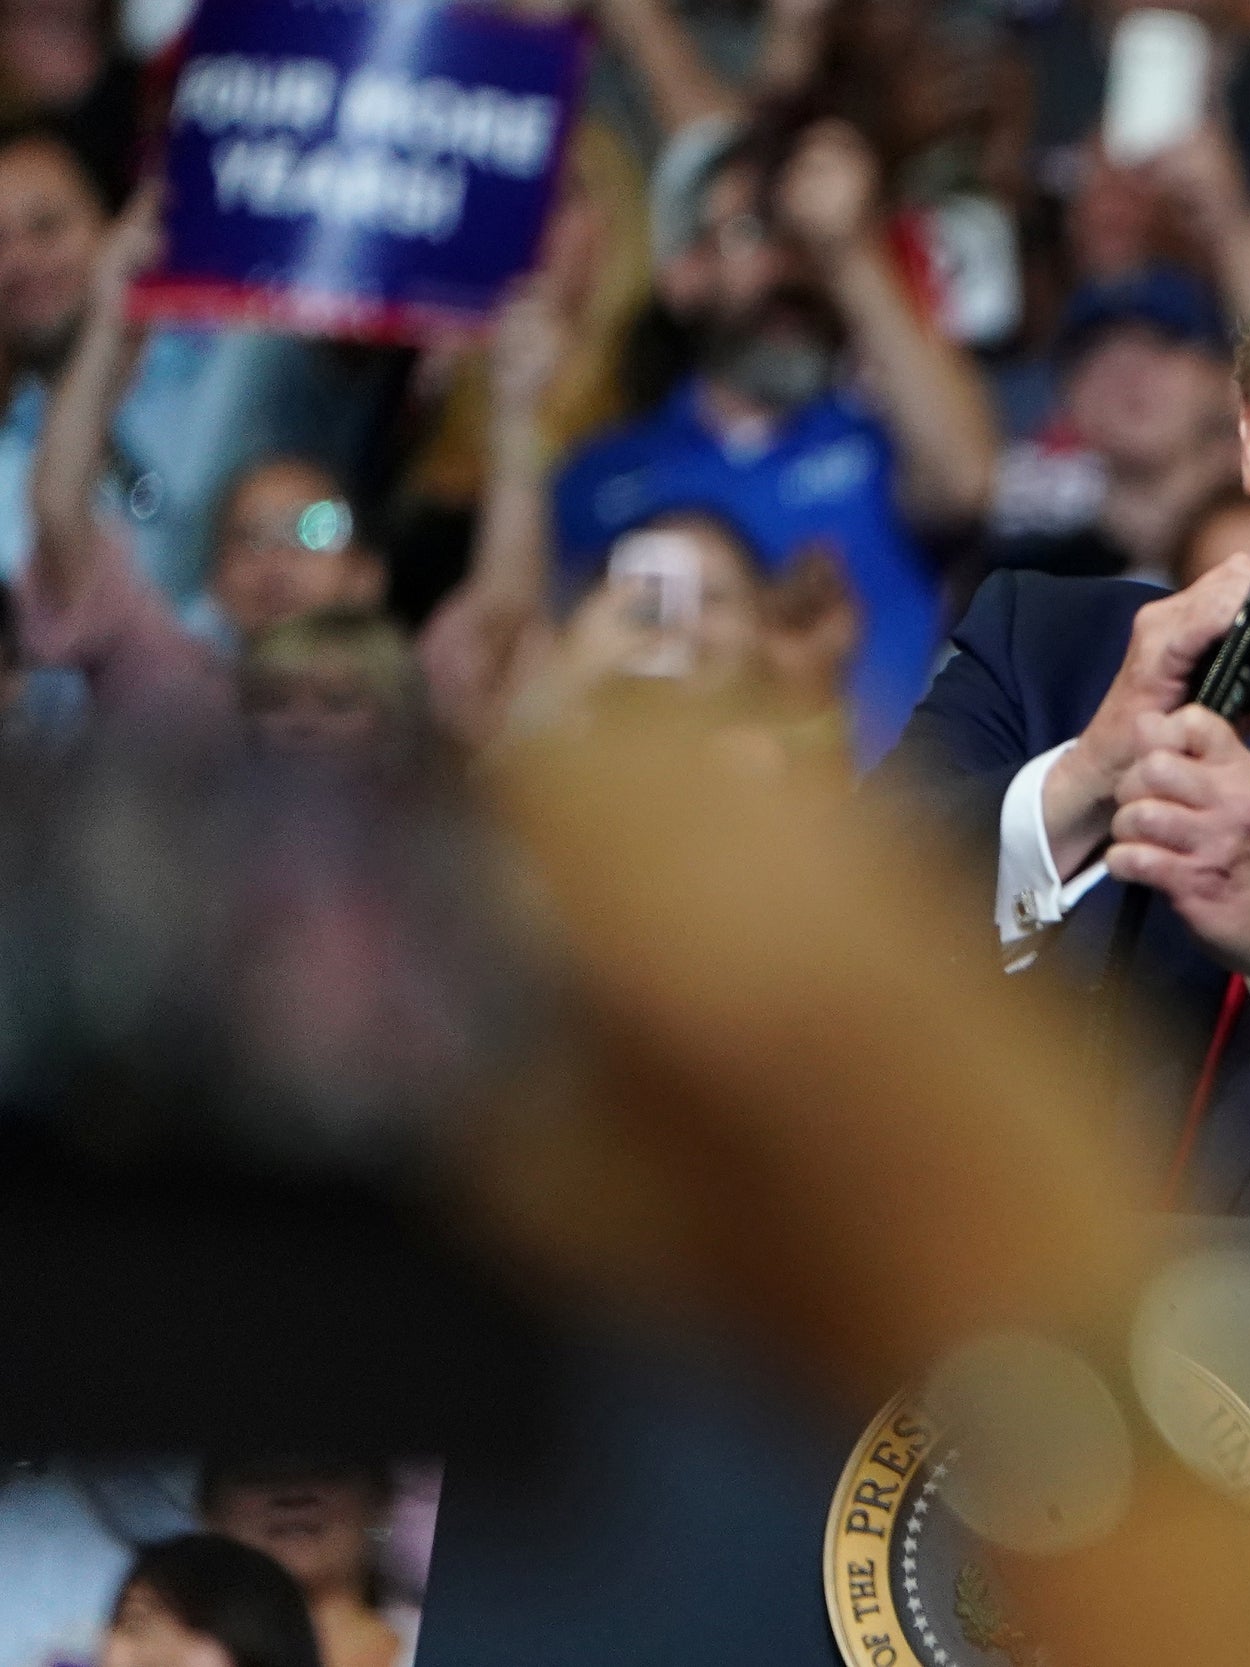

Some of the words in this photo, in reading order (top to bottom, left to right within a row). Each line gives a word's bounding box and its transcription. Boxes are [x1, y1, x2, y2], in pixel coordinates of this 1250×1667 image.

[845, 1412, 931, 1538] PRES
[848, 1557, 880, 1623] THE
[862, 1633, 897, 1667] OF
